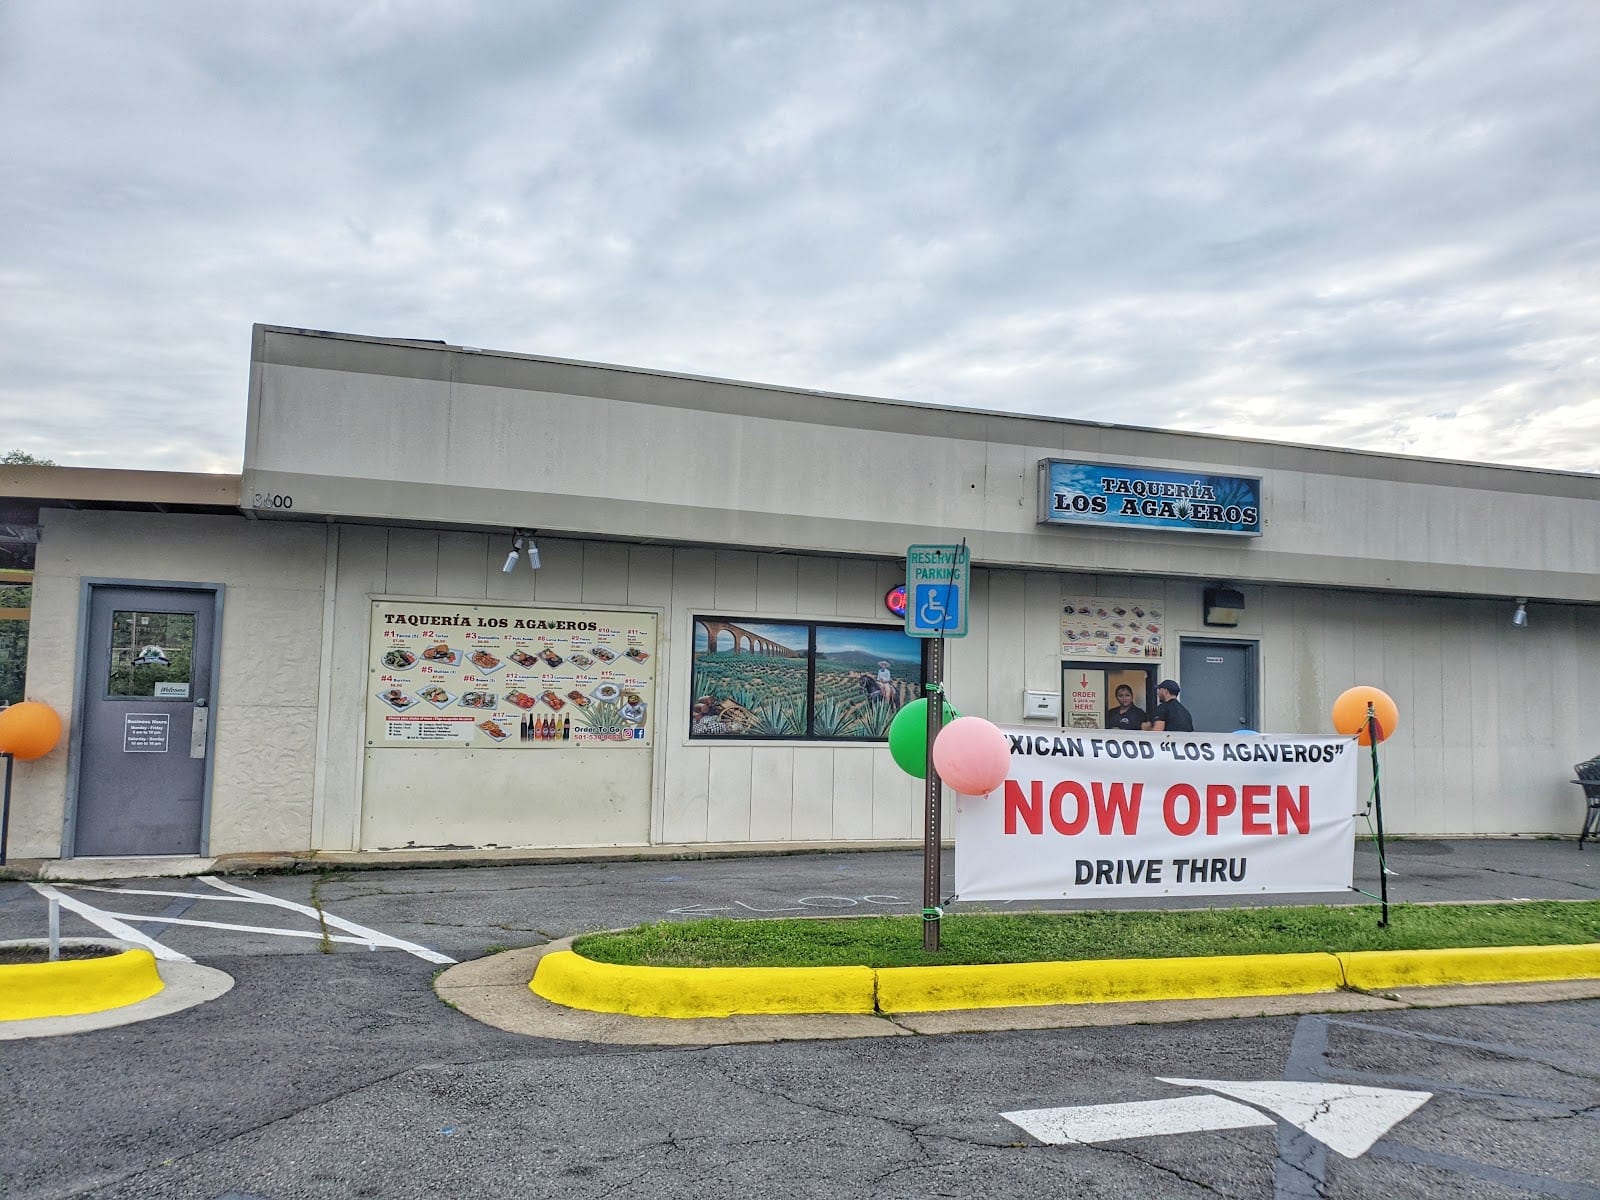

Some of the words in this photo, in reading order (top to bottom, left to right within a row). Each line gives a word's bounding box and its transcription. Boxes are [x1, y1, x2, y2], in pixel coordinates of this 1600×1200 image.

[1102, 478, 1216, 501] TAQUERÍA
[1054, 493, 1107, 513] LOS
[911, 552, 965, 564] RESERVED
[915, 567, 960, 580] PARKING
[384, 613, 472, 627] TAQUERÍA
[477, 617, 508, 628] LOS
[384, 630, 395, 638] #1
[422, 630, 434, 638] #2
[465, 632, 477, 640] #3
[421, 666, 433, 674] #5
[381, 674, 393, 682] #4
[1004, 734, 1085, 757] XICAN
[1091, 738, 1155, 760] FOOD
[1004, 780, 1144, 836] NOW
[1162, 783, 1311, 837] OPEN
[1074, 859, 1164, 886] DRIVE
[1172, 857, 1248, 884] THRU
